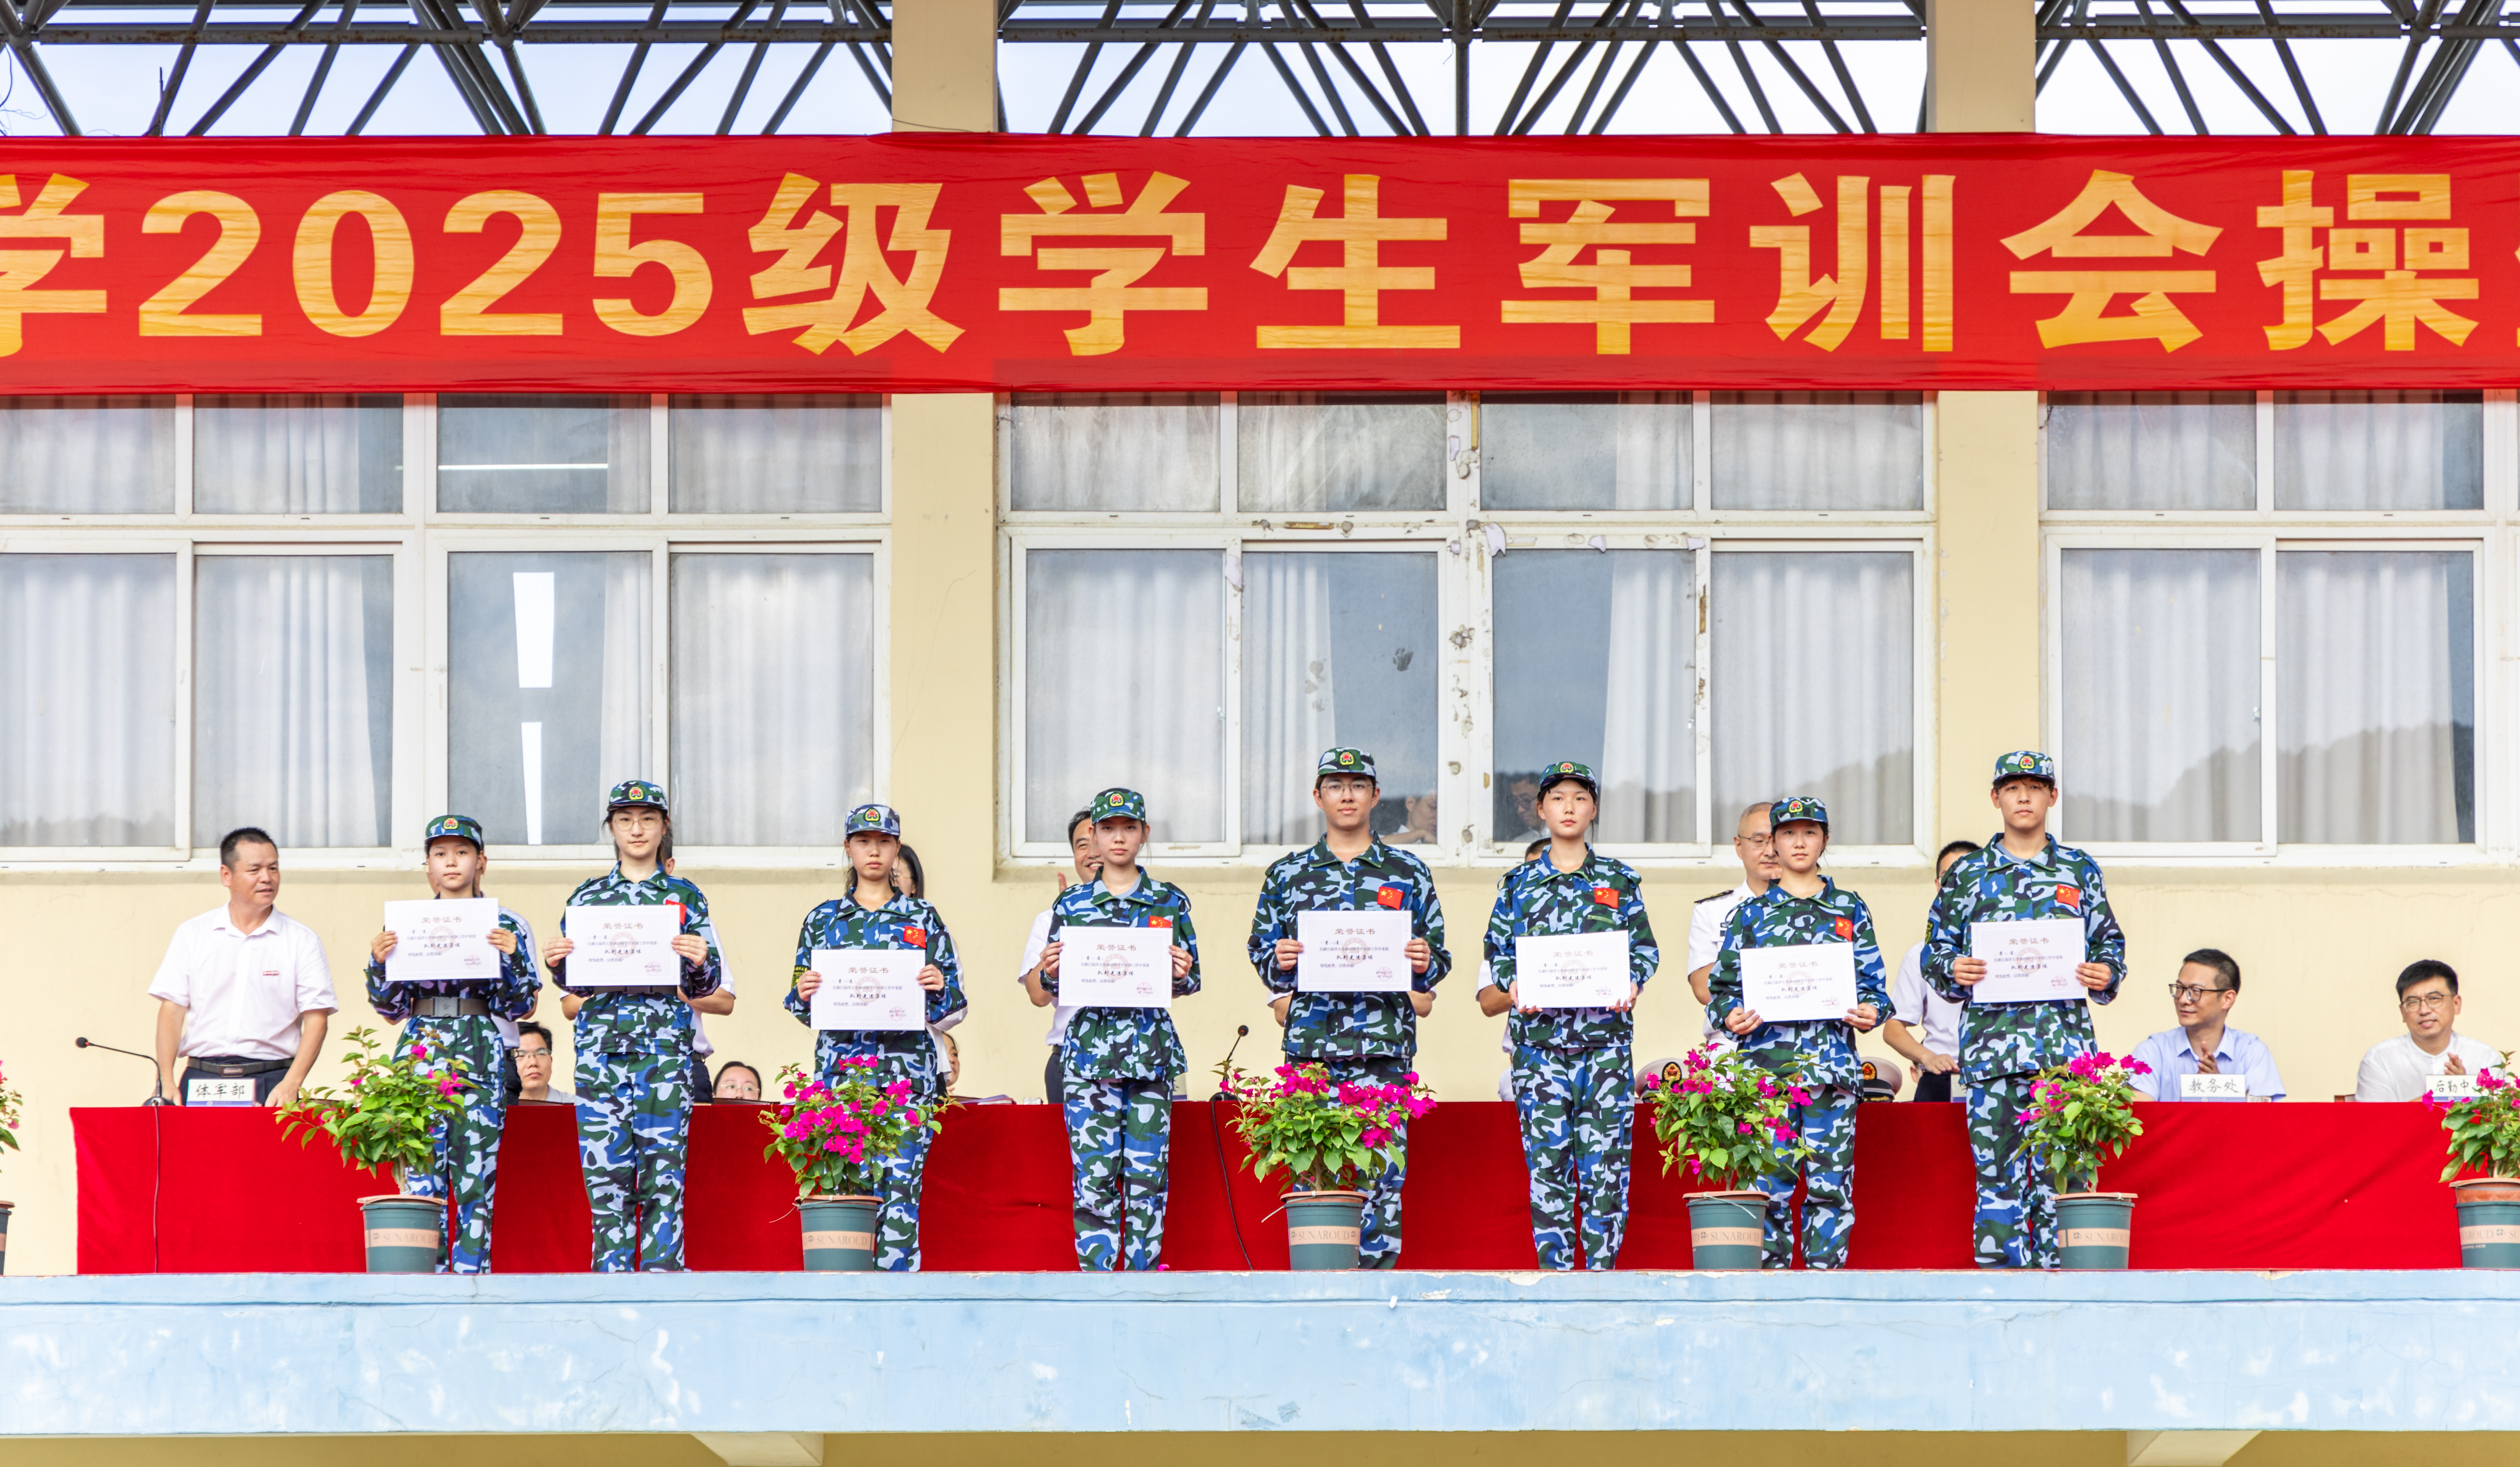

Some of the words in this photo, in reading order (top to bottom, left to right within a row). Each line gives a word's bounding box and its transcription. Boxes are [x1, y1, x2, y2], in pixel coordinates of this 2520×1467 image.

[0, 170, 2520, 357] 学2025级学生军训会操
[195, 1083, 245, 1099] 体军部
[2189, 1078, 2239, 1093] 教务处
[2435, 1079, 2476, 1094] 后勤中
[817, 1235, 867, 1246] SUNAROUD
[1298, 1230, 1349, 1240] SUNAROUD
[1711, 1231, 1759, 1242] SUNAROUD
[2085, 1233, 2129, 1243] SUNAROU
